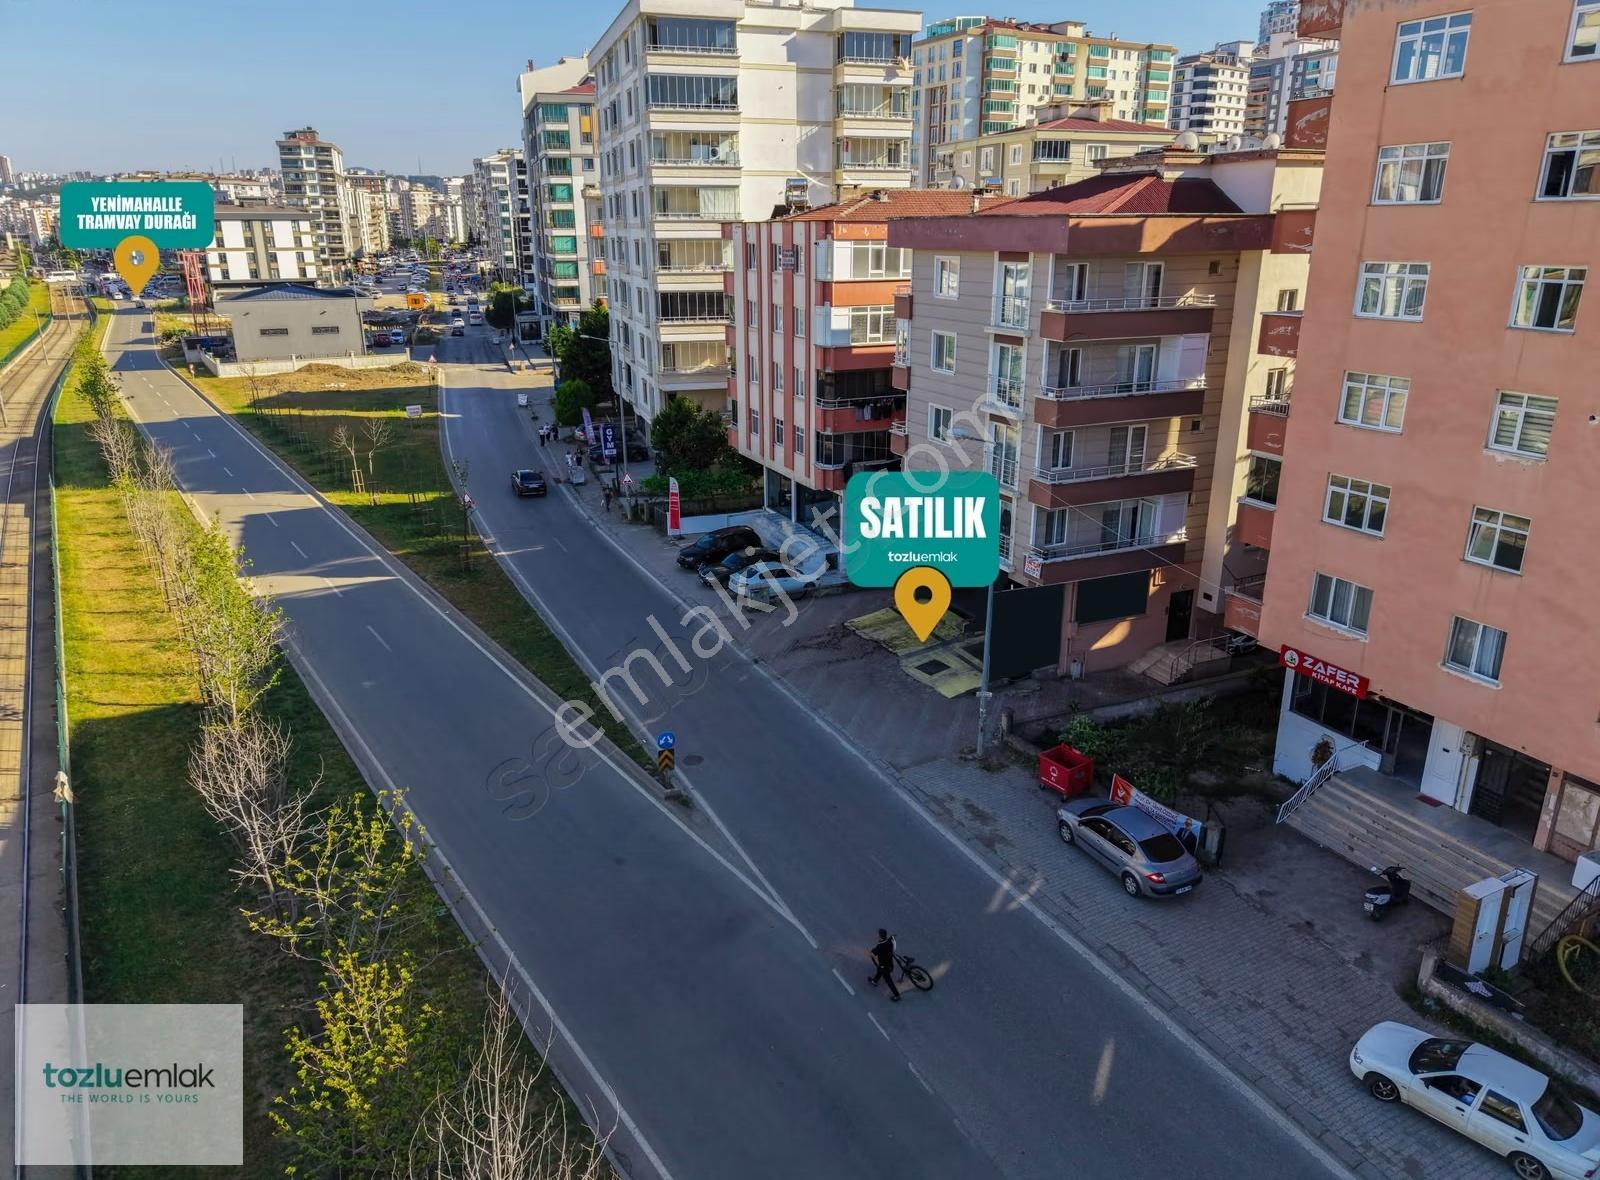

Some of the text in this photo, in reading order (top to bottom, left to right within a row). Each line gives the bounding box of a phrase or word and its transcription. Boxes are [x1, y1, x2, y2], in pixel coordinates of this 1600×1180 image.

[606, 428, 615, 448] GYM
[1303, 655, 1360, 688] ZAFER
[1335, 680, 1357, 695] KAFE
